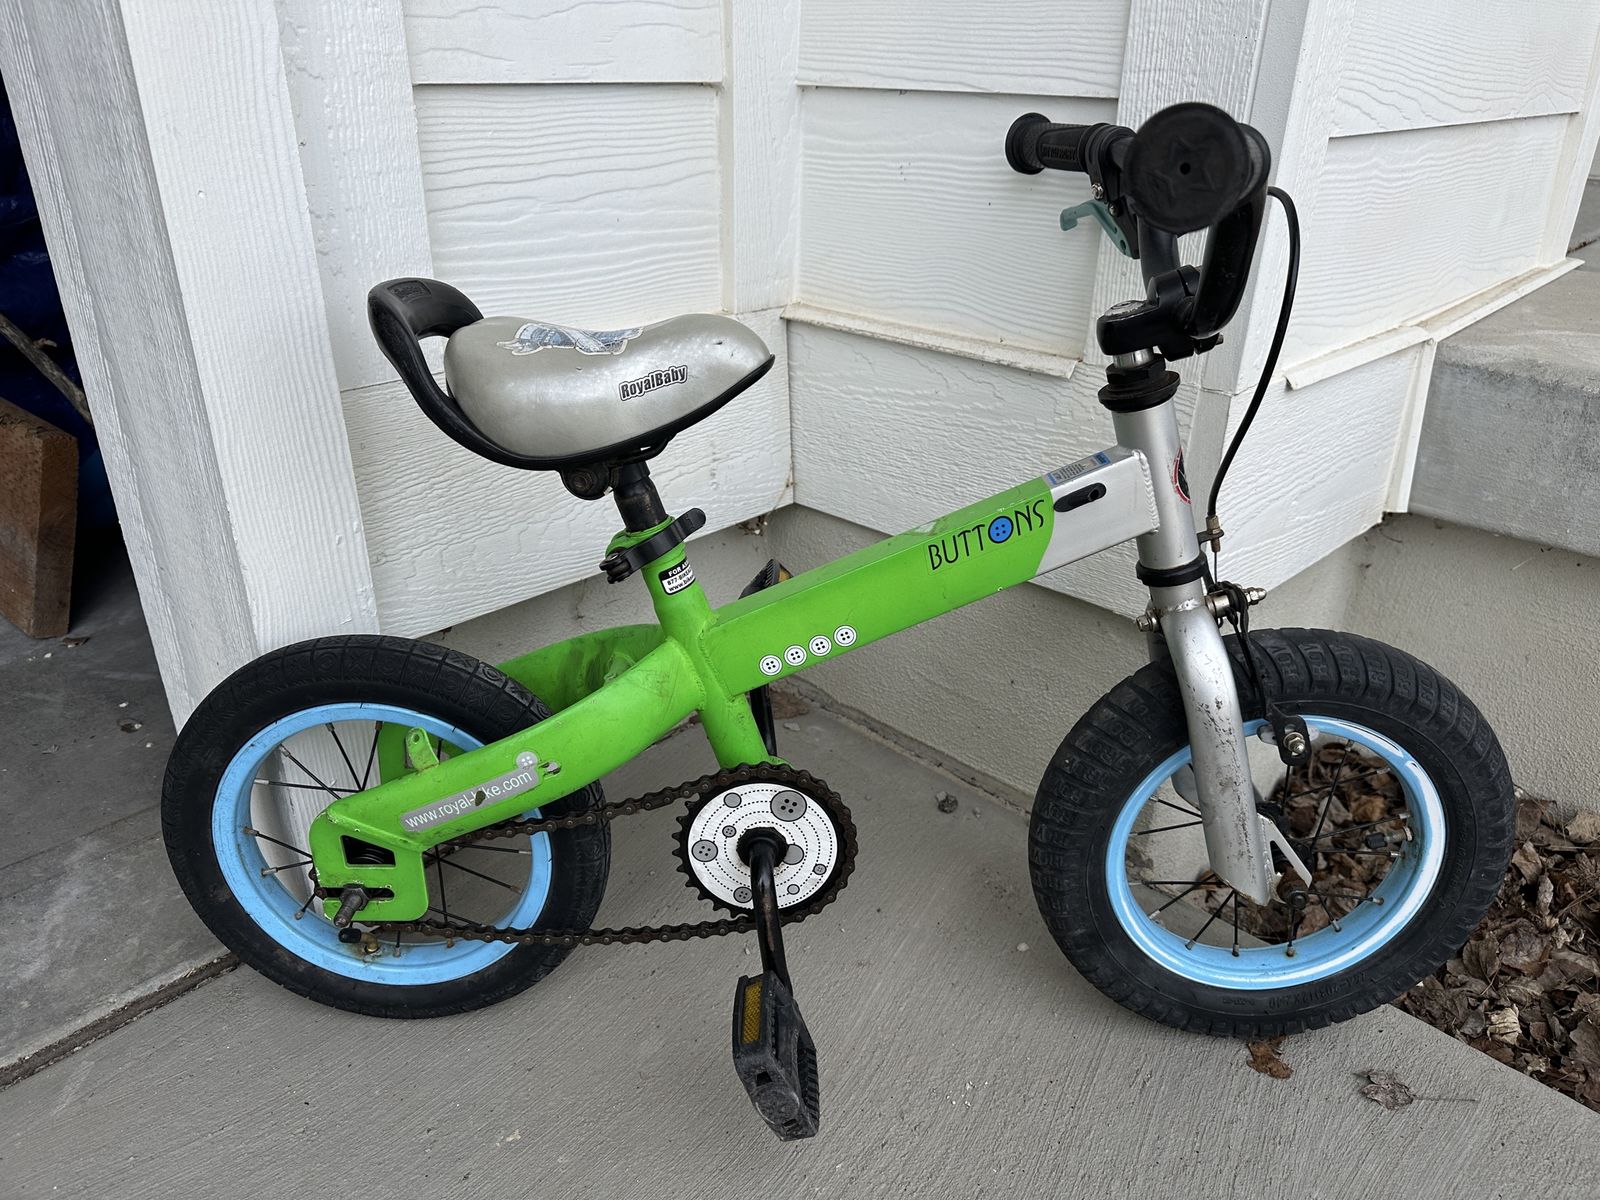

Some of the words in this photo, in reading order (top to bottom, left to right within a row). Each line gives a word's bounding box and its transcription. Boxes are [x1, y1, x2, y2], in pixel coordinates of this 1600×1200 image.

[620, 366, 687, 399] RoyalBaby
[668, 566, 682, 577] FOR
[405, 772, 533, 828] www.royal-ke.com
